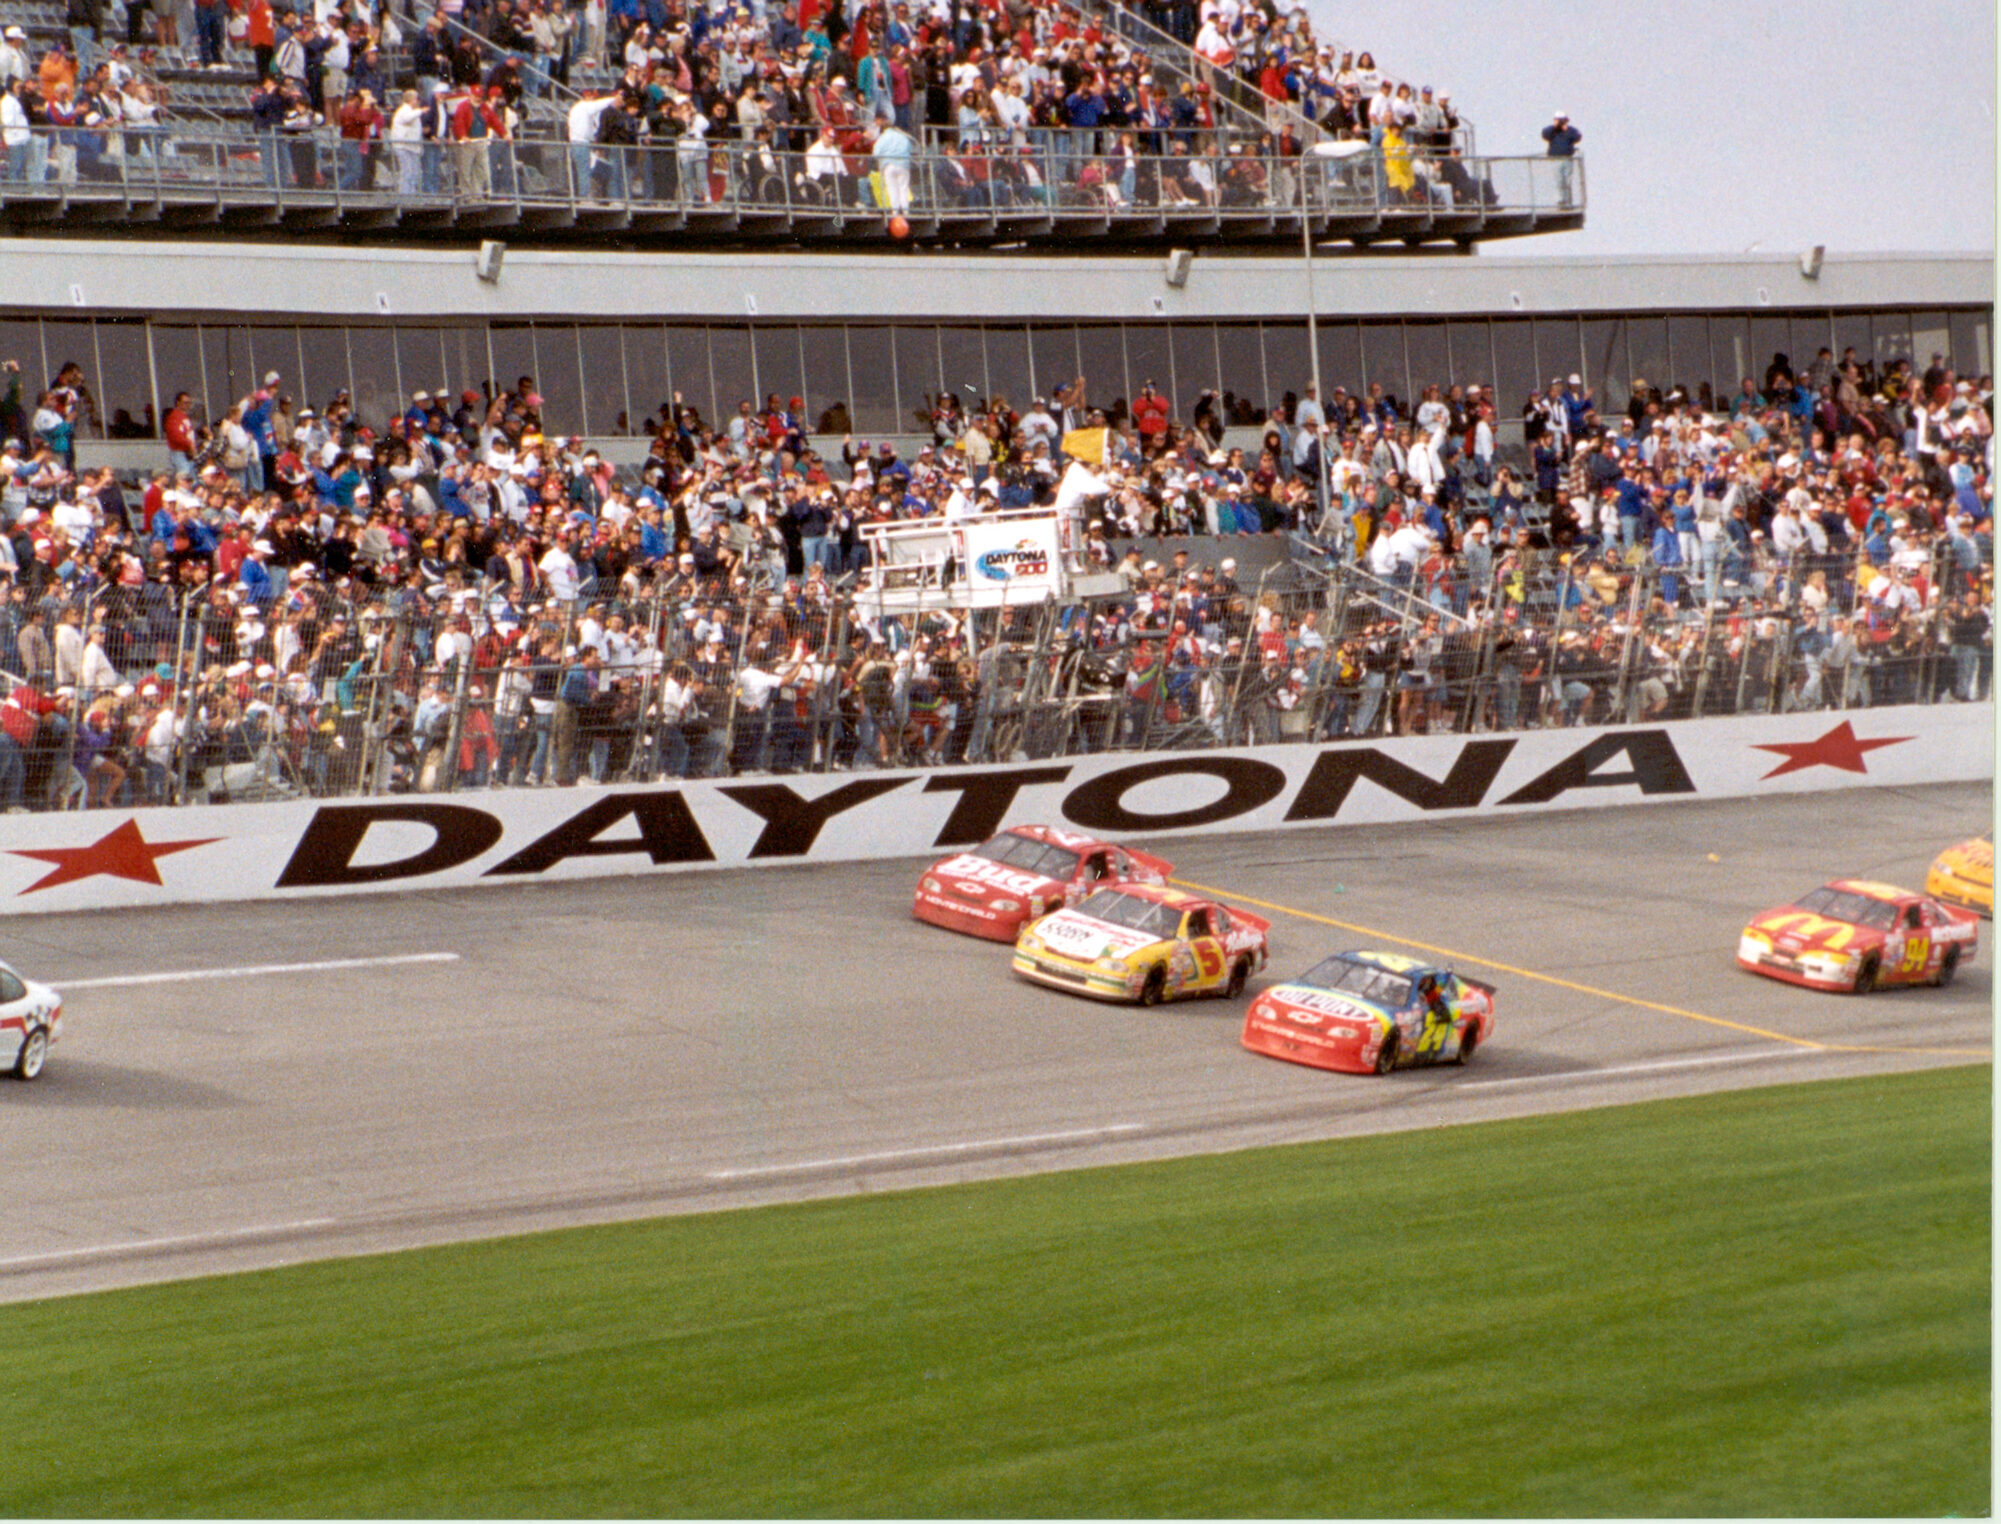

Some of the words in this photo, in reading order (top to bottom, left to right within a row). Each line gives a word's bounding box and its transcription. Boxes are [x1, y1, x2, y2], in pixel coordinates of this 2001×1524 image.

[985, 549, 1047, 566] DAYTONA
[274, 729, 1696, 887] DAYTONA
[936, 854, 1053, 894] Bud
[1193, 940, 1221, 977] 5
[1902, 937, 1930, 973] 94
[1416, 1010, 1449, 1053] 24
